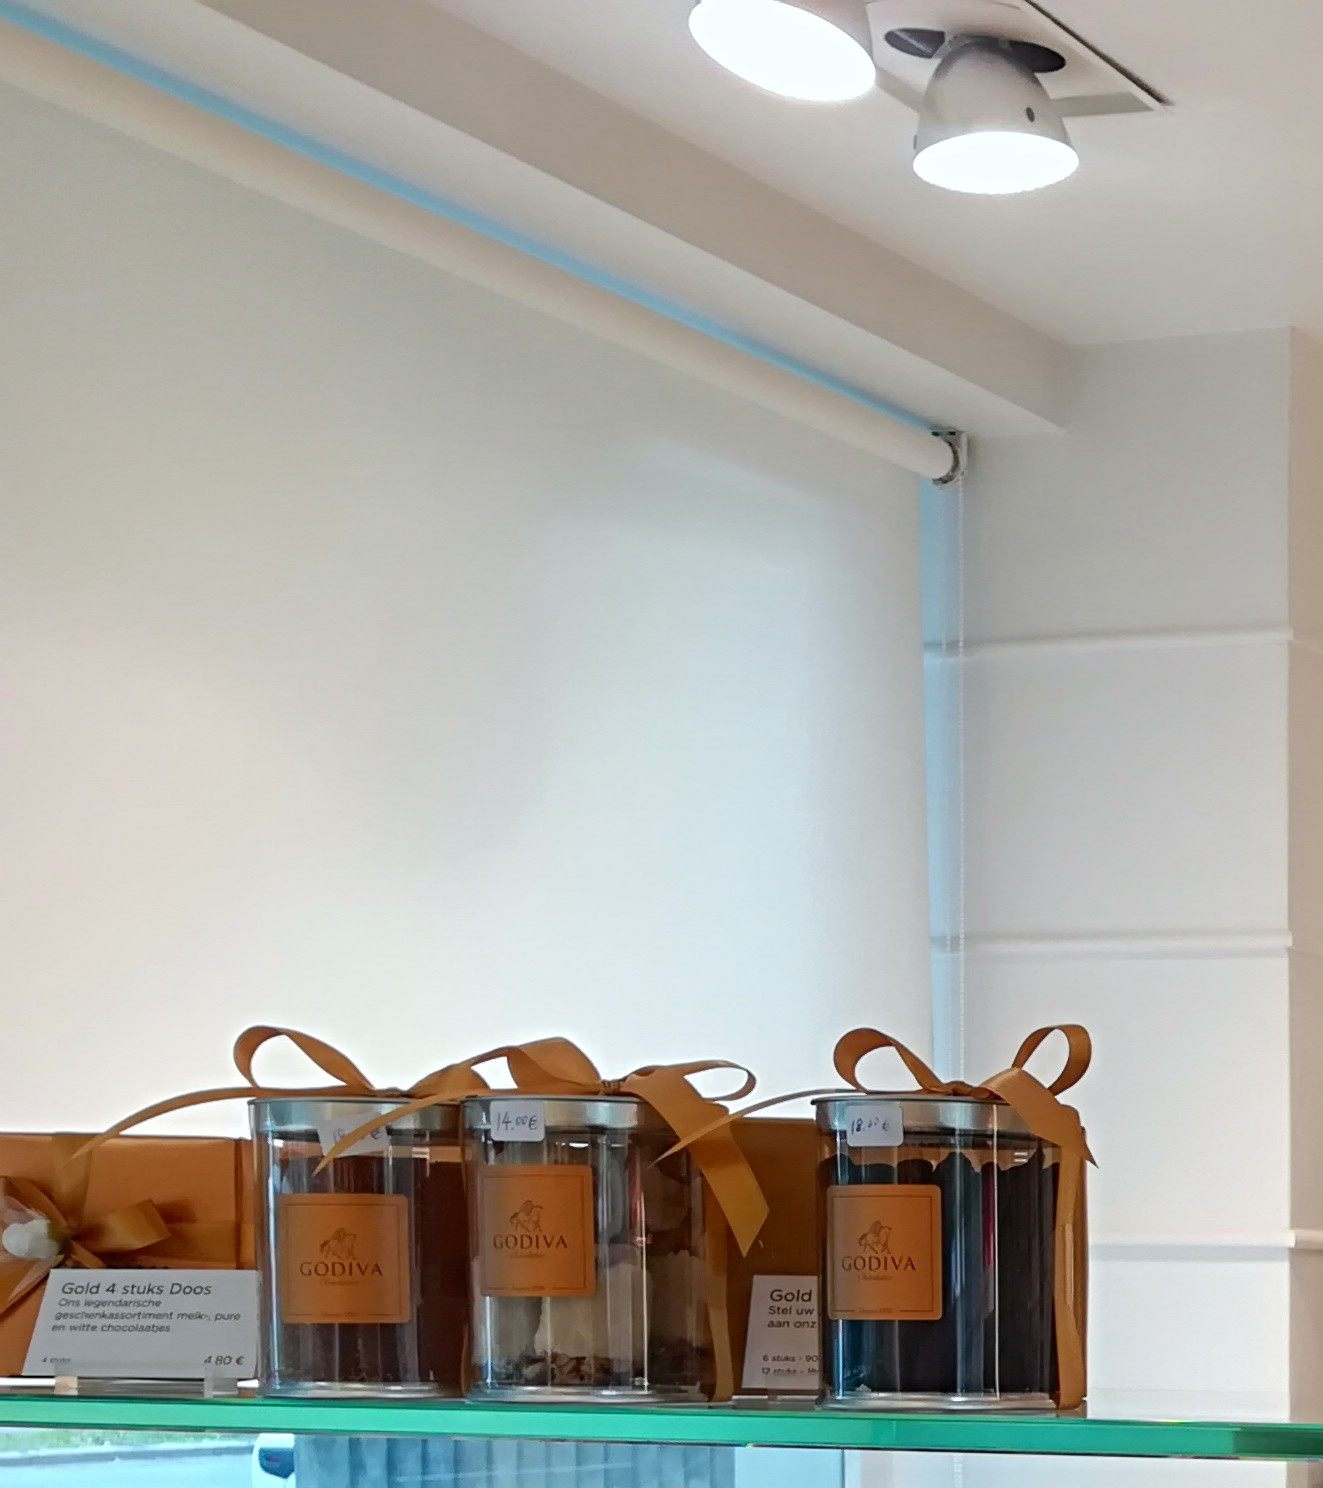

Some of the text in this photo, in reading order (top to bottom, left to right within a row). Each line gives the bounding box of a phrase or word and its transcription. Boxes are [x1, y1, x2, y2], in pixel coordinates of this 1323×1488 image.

[493, 1233, 568, 1250] GODIVA
[300, 1261, 383, 1277] GODIVA
[841, 1256, 917, 1272] GODIVA
[61, 1282, 212, 1296] Gold 4 stuks Doos
[770, 1289, 812, 1302] Gold
[58, 1298, 80, 1307] Ons
[768, 1305, 814, 1315] Stel uw
[214, 1313, 241, 1322] pure
[51, 1324, 65, 1332] en
[70, 1323, 98, 1332] witte
[794, 1321, 817, 1329] onz
[235, 1355, 245, 1366] €
